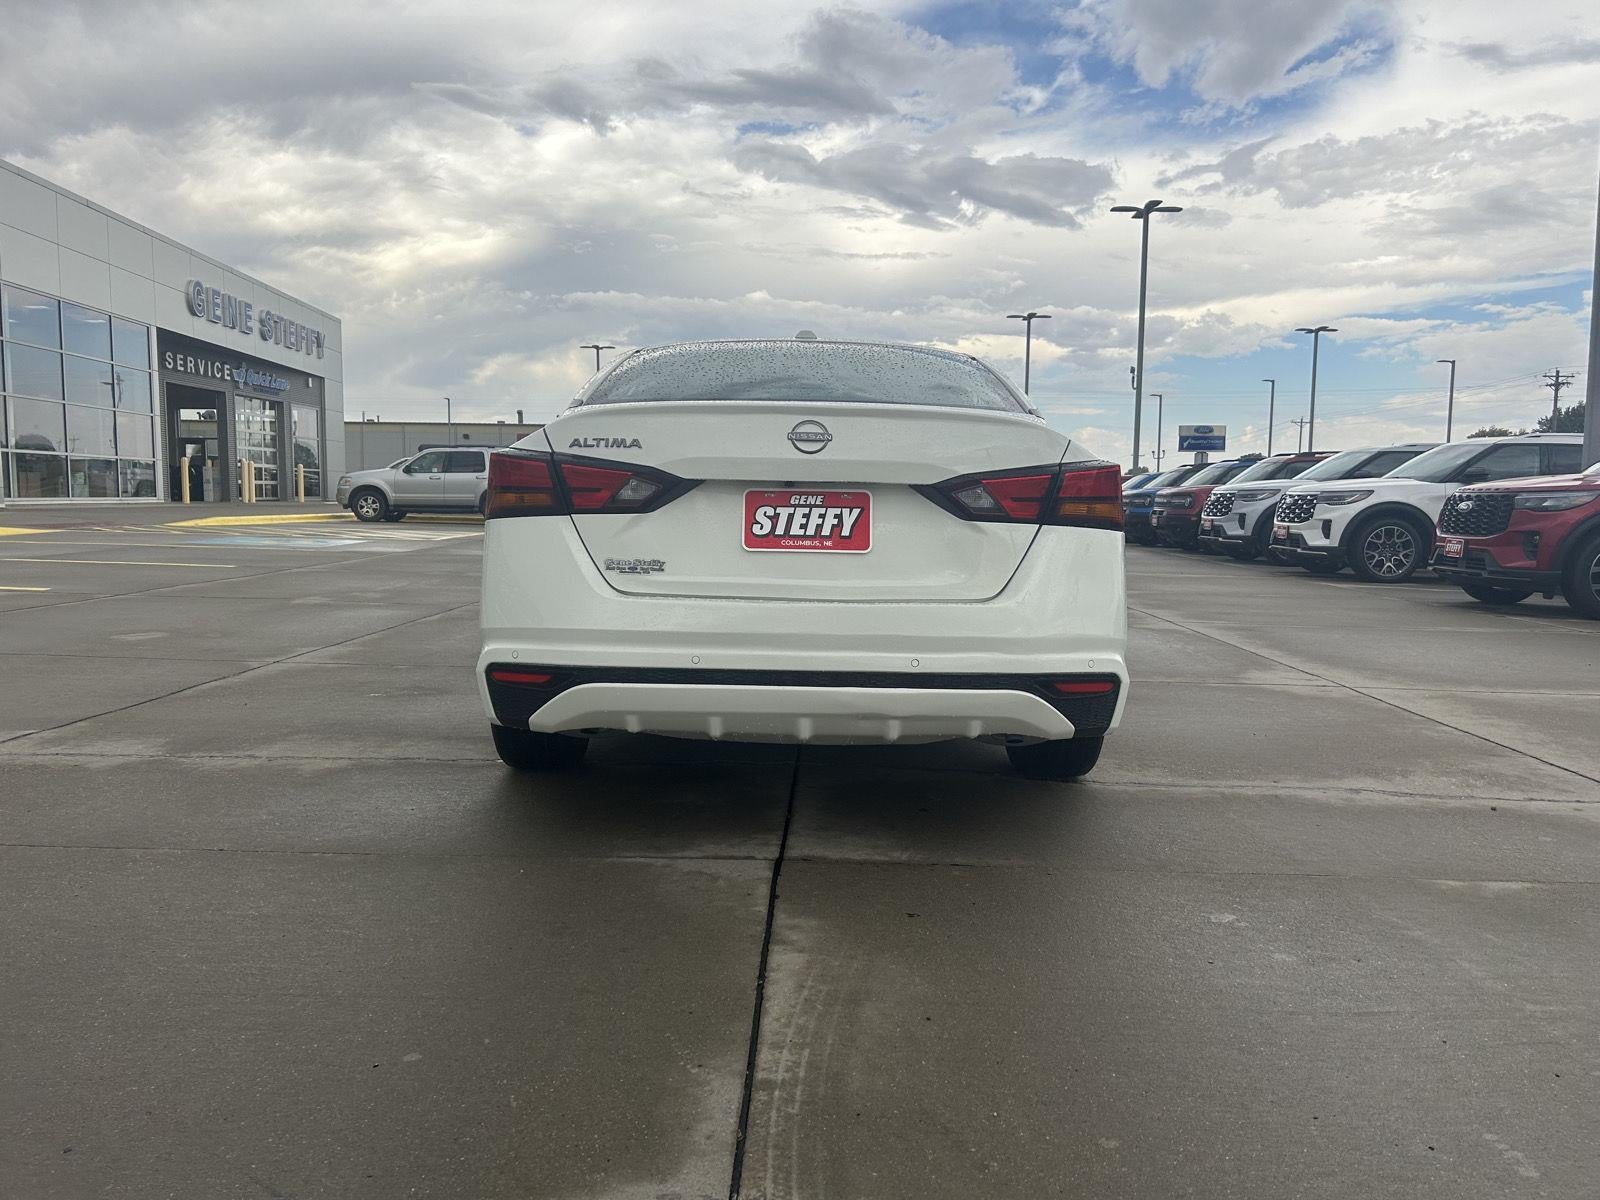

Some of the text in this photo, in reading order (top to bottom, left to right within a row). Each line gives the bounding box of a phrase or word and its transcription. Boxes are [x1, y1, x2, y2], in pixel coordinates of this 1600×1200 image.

[185, 279, 326, 359] GENE STEFFY
[165, 351, 231, 380] SERVICE
[788, 432, 832, 441] NISSAN
[568, 437, 643, 449] ALTIMA
[790, 494, 824, 505] GENE
[751, 505, 863, 538] STEFFY
[780, 539, 822, 548] COLUMBUS,
